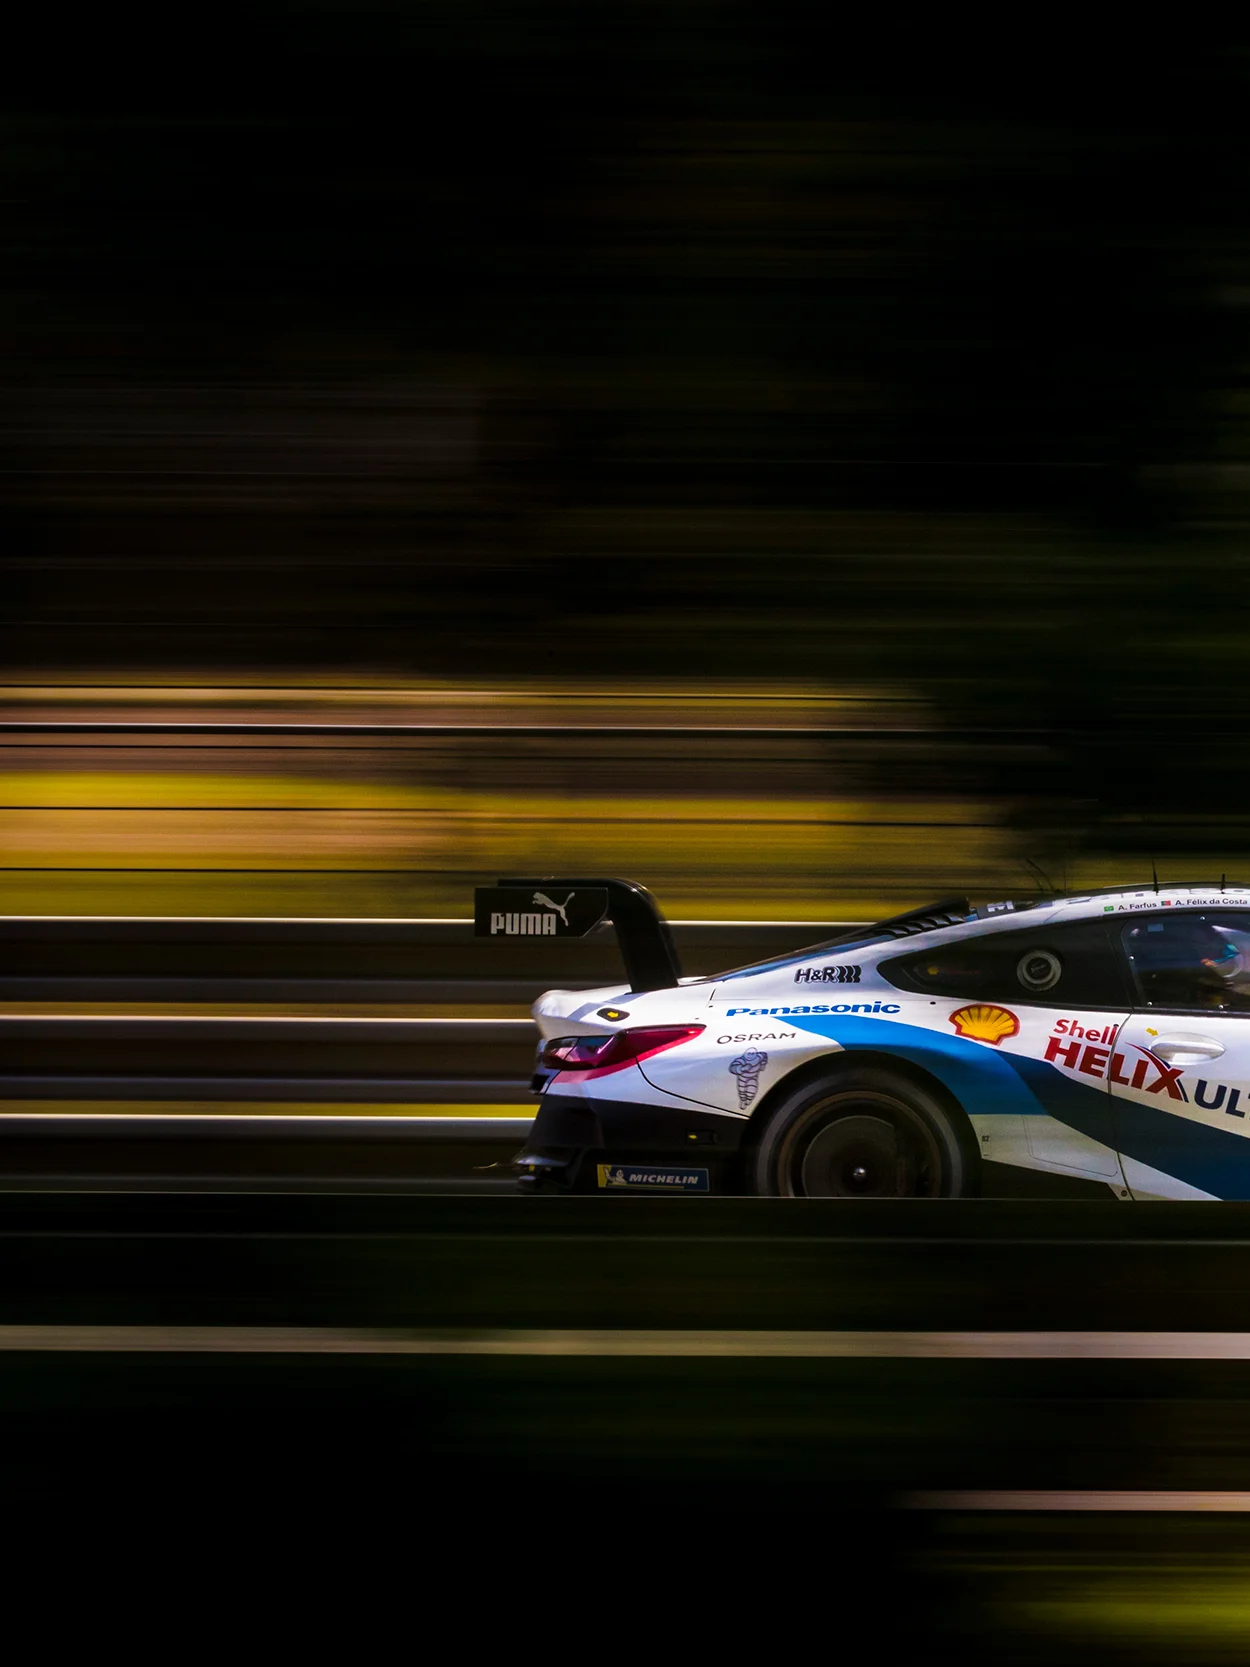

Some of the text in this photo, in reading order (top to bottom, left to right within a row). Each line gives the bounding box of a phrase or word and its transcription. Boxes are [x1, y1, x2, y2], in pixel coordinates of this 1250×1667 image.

[1129, 902, 1157, 910] Farfus
[1187, 898, 1208, 906] Félix
[490, 912, 557, 936] PUMA
[794, 966, 837, 984] H&R
[726, 1001, 902, 1017] Panasonic
[716, 1032, 797, 1045] OSRAM
[1053, 1018, 1118, 1046] Shell
[1043, 1036, 1190, 1103] HELIX
[628, 1173, 699, 1184] MICHELIN
